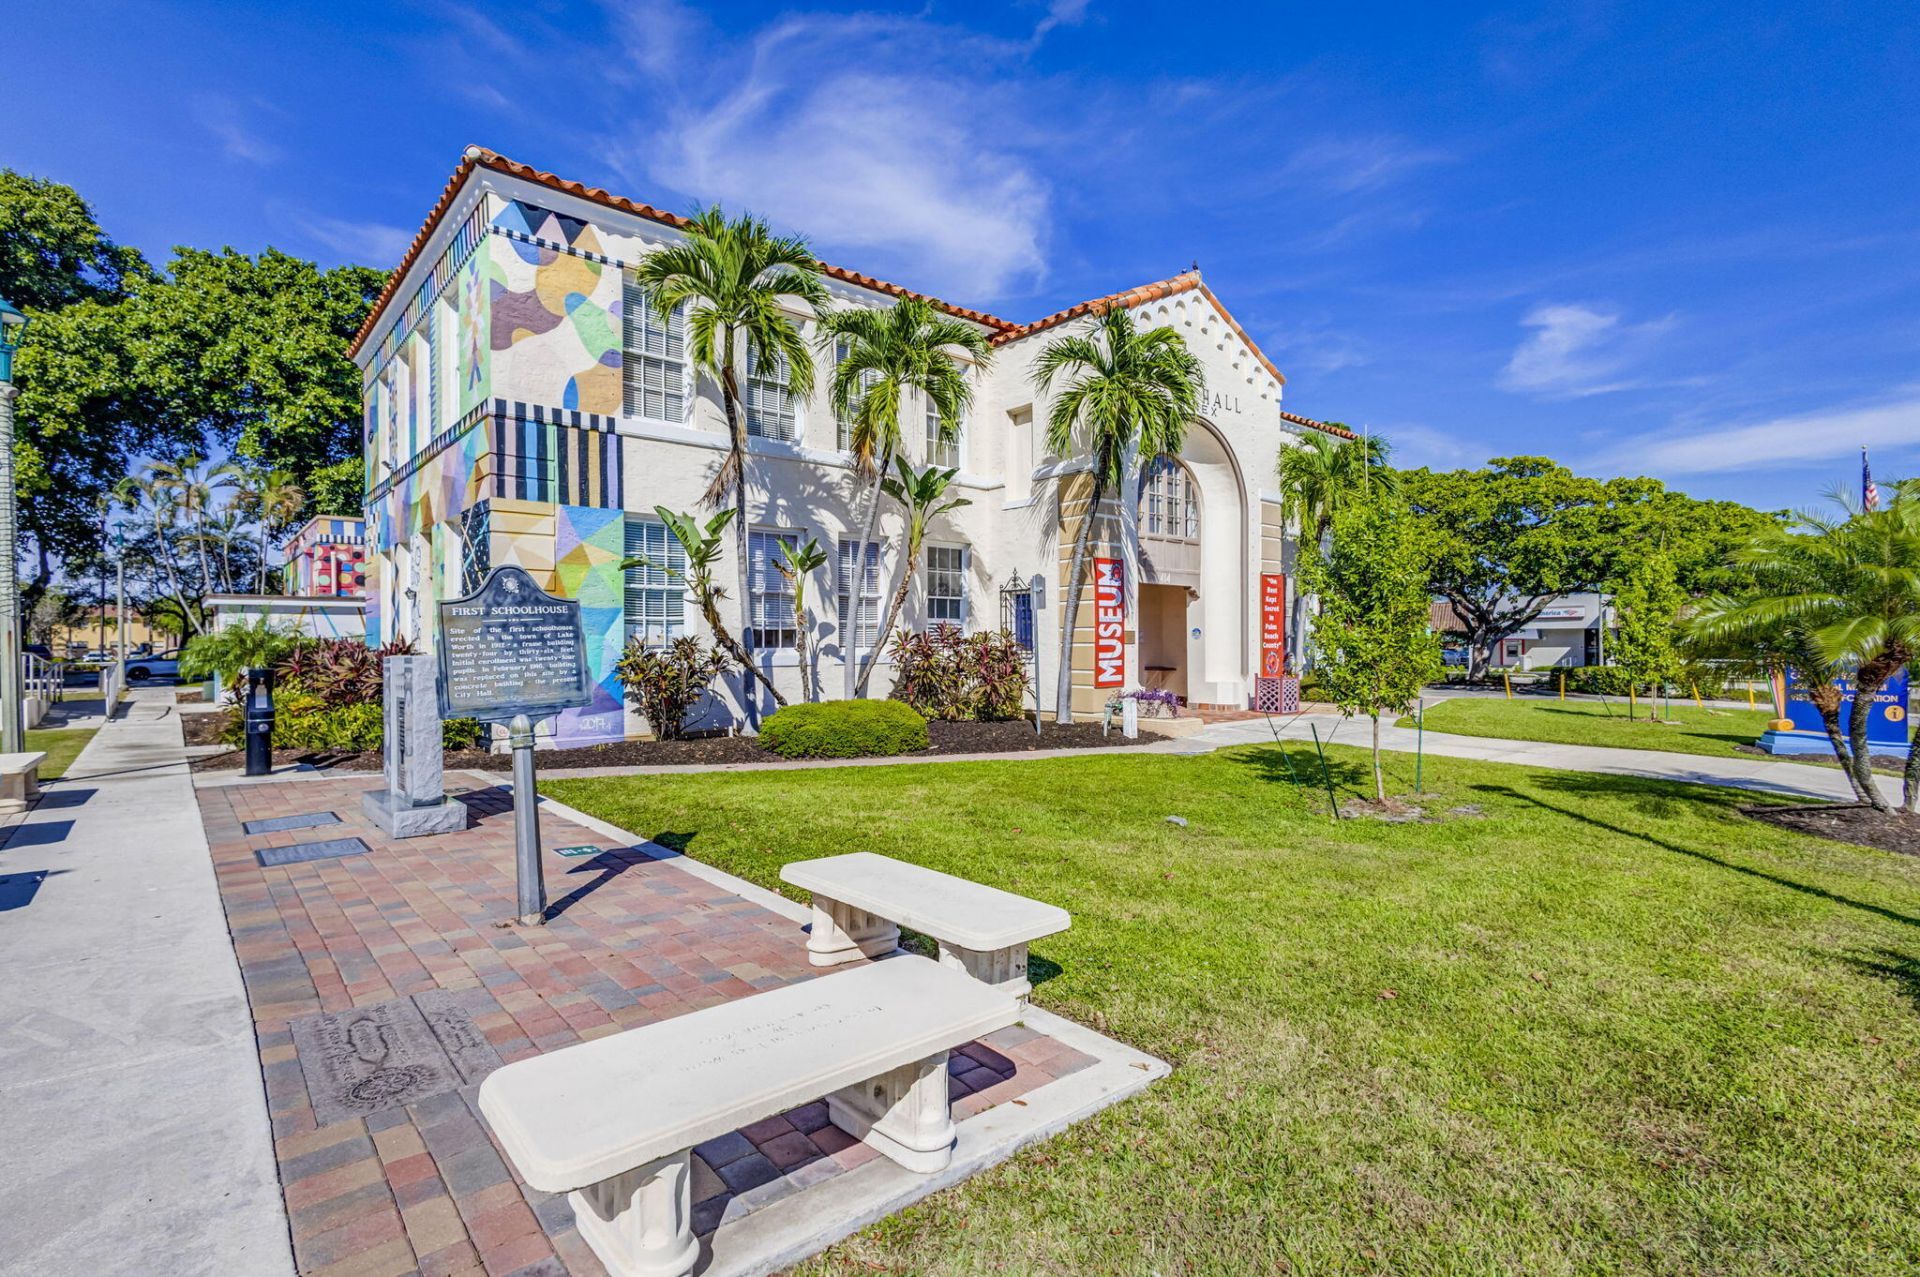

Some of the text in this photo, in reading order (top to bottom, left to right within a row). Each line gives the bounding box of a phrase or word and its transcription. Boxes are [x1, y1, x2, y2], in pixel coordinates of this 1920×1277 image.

[1202, 389, 1241, 414] HALL
[1265, 595, 1277, 604] Kept
[452, 605, 569, 616] FIRST SCHOOLHOUSE
[1264, 604, 1280, 612] Secret
[1098, 563, 1123, 683] MUSEUM
[450, 627, 465, 635] Site
[1264, 632, 1279, 640] Beach
[473, 673, 505, 681] replaced
[454, 682, 487, 690] concrete
